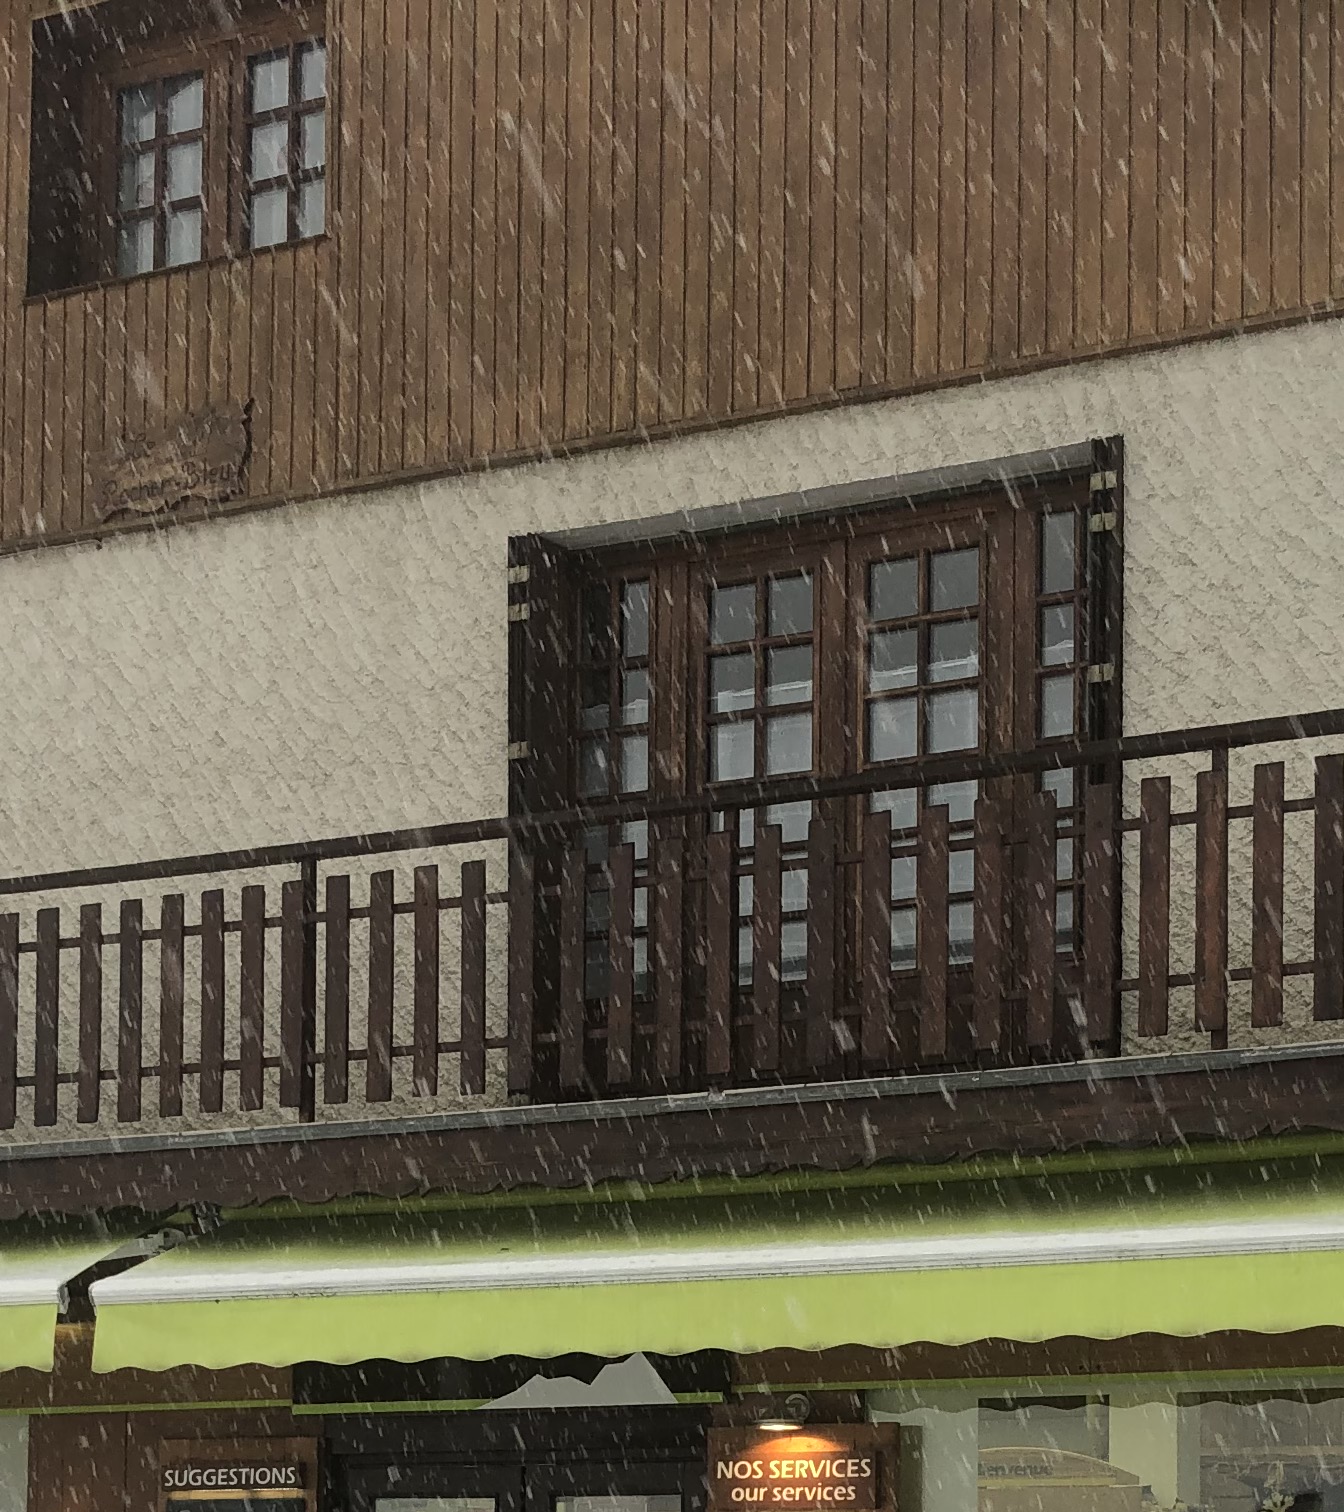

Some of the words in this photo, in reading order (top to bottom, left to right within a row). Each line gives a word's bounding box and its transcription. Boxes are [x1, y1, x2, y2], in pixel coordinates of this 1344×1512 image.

[164, 1467, 296, 1486] SUGGESTIONS
[717, 1461, 763, 1479] NOS
[769, 1458, 871, 1479] SERVICES
[731, 1487, 768, 1501] our
[772, 1483, 856, 1501] services
